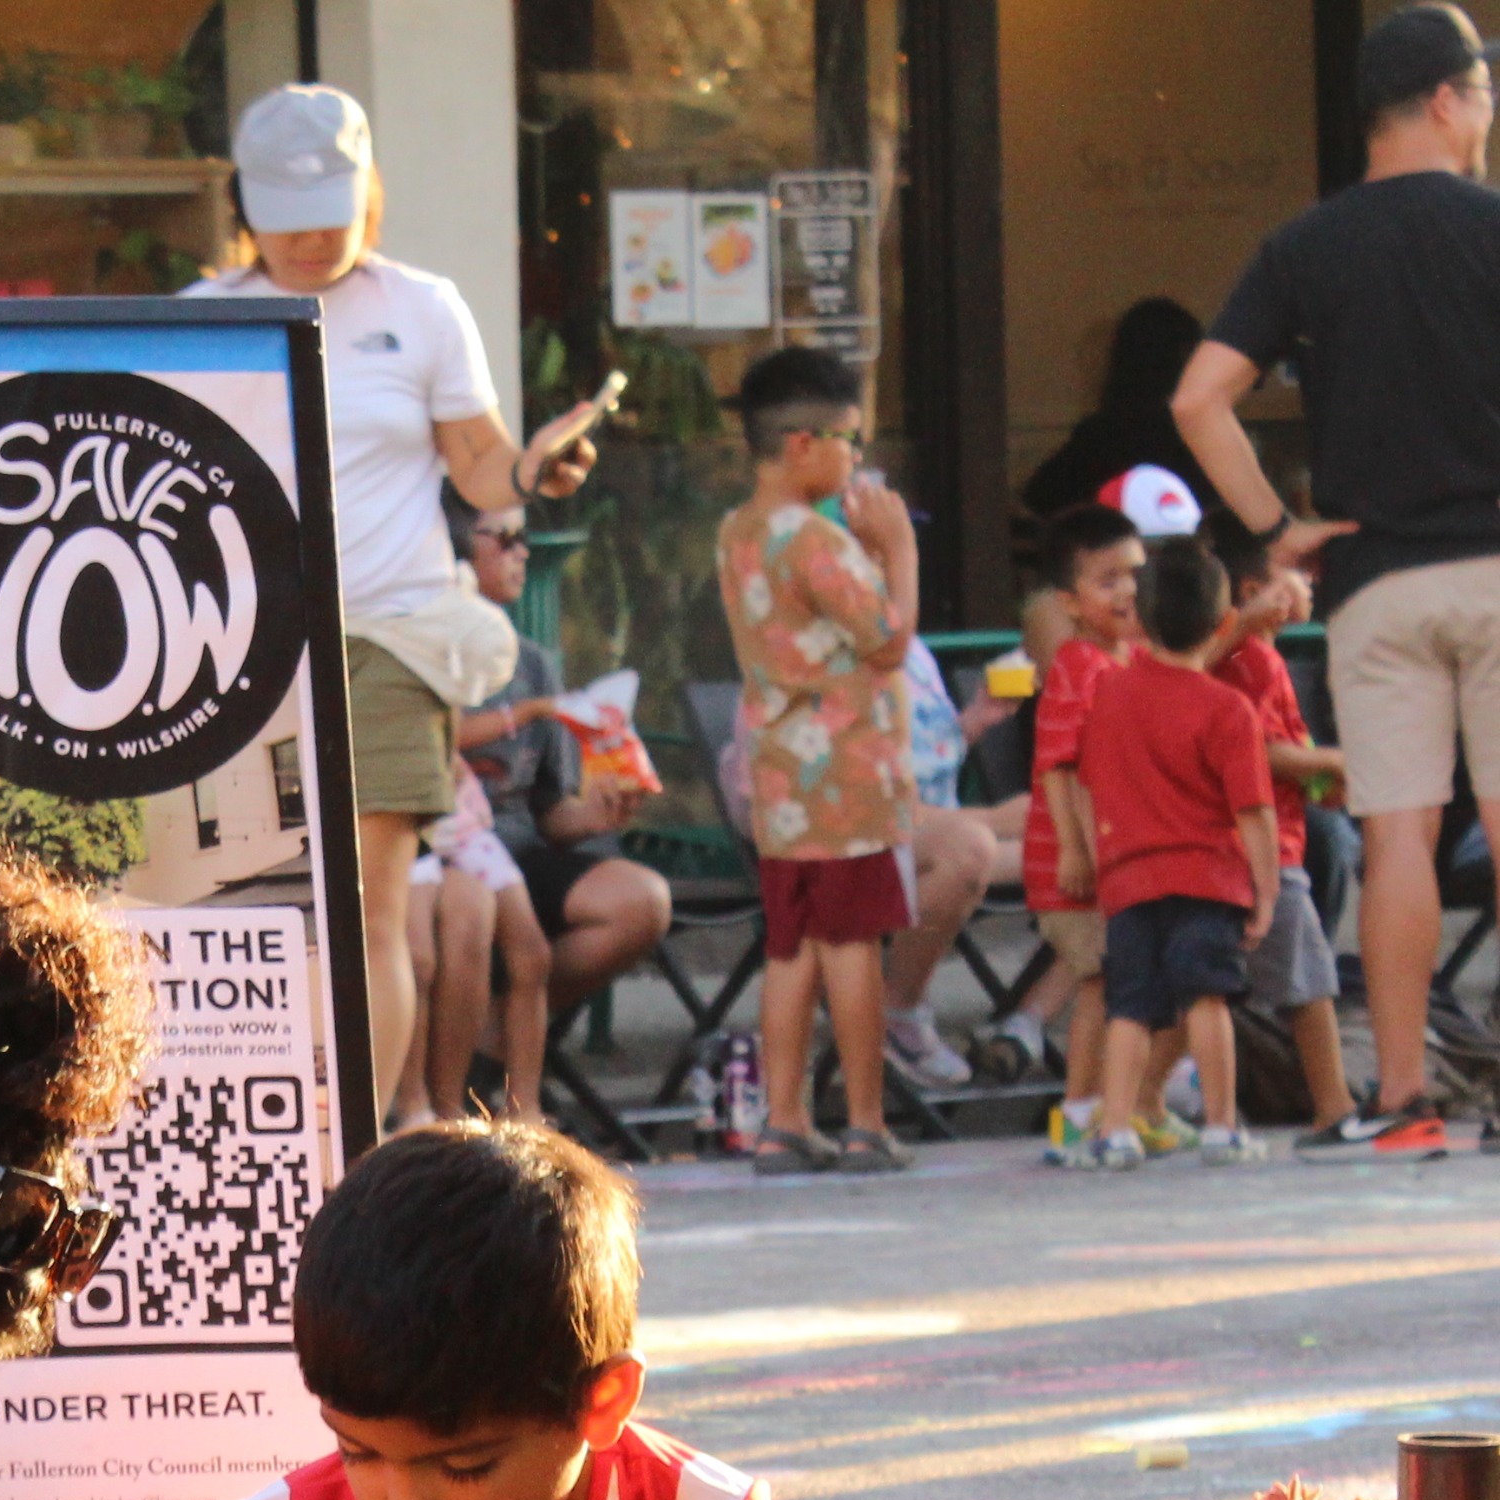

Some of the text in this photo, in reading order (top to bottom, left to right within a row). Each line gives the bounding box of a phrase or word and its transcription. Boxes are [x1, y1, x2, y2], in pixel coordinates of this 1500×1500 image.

[208, 466, 235, 498] CA
[54, 738, 88, 759] ON
[117, 697, 220, 759] WILSHIRE
[190, 930, 286, 963] THE
[230, 1022, 277, 1034] WOW
[283, 1025, 291, 1034] a
[121, 1390, 274, 1420] THREAT.
[9, 1460, 97, 1479] Fullerton
[103, 1458, 143, 1482] City
[148, 1456, 222, 1475] Council
